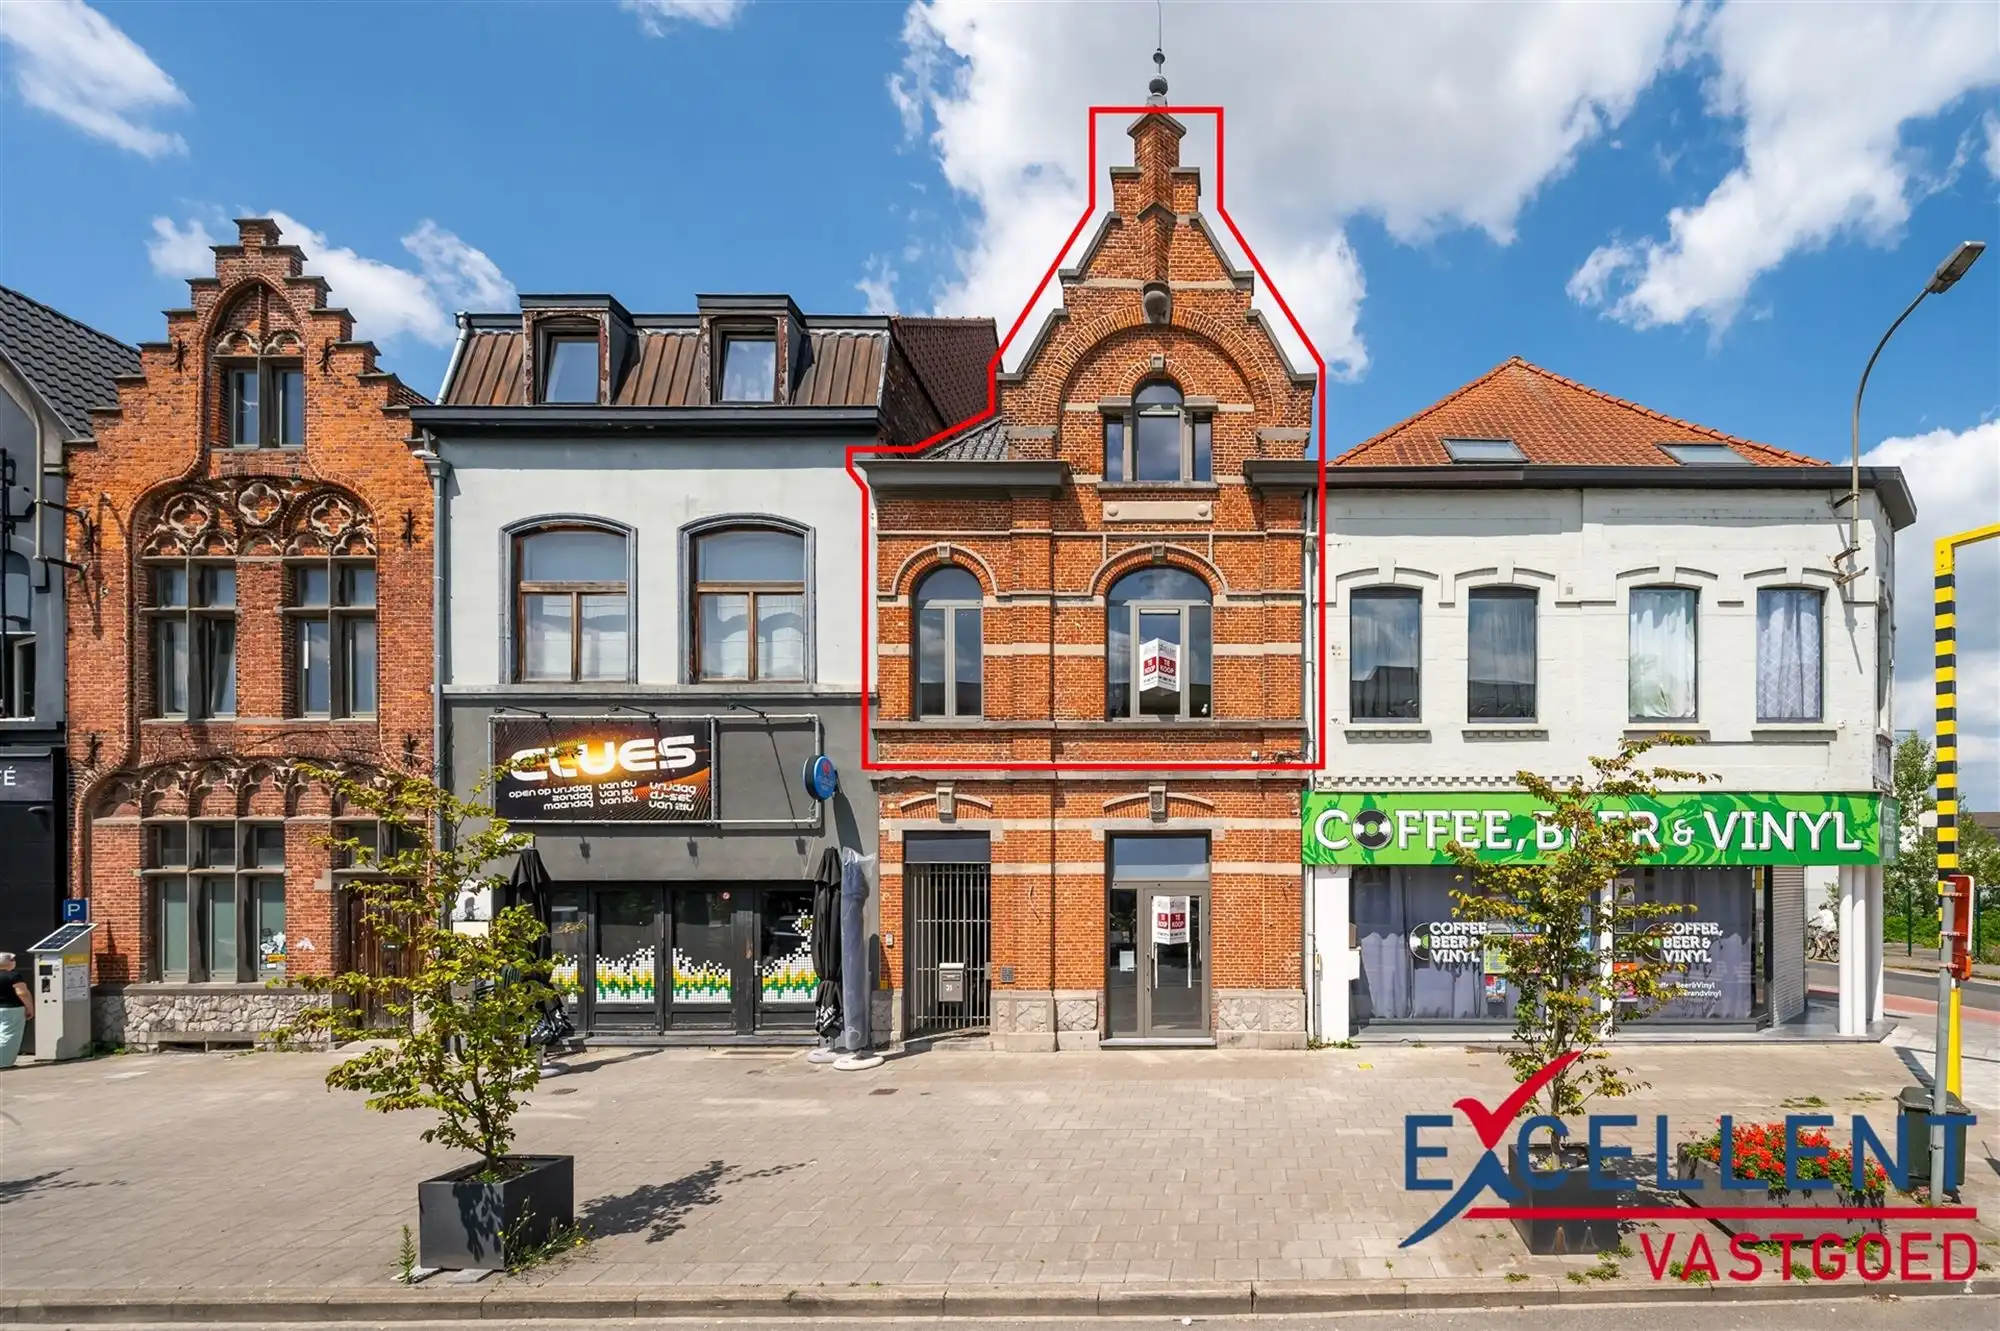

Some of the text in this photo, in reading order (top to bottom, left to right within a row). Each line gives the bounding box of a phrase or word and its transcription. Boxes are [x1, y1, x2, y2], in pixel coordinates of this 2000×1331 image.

[510, 735, 696, 781] CLUES
[552, 784, 593, 794] vrijdag
[598, 781, 620, 790] van
[649, 782, 697, 795] vrijdag
[552, 792, 593, 802] zondag
[599, 789, 620, 798] van
[543, 799, 594, 810] maandag
[600, 797, 621, 805] van
[648, 800, 673, 810] van
[1314, 809, 1528, 853] COFFEE,
[1672, 819, 1695, 847] &
[1703, 811, 1863, 851] VINYL
[67, 903, 80, 916] P
[1429, 922, 1492, 935] COFFEE,
[1431, 936, 1468, 949] BEER
[1663, 936, 1711, 949] BEER &
[1431, 949, 1480, 963] VINYL
[1663, 949, 1712, 963] VINYL
